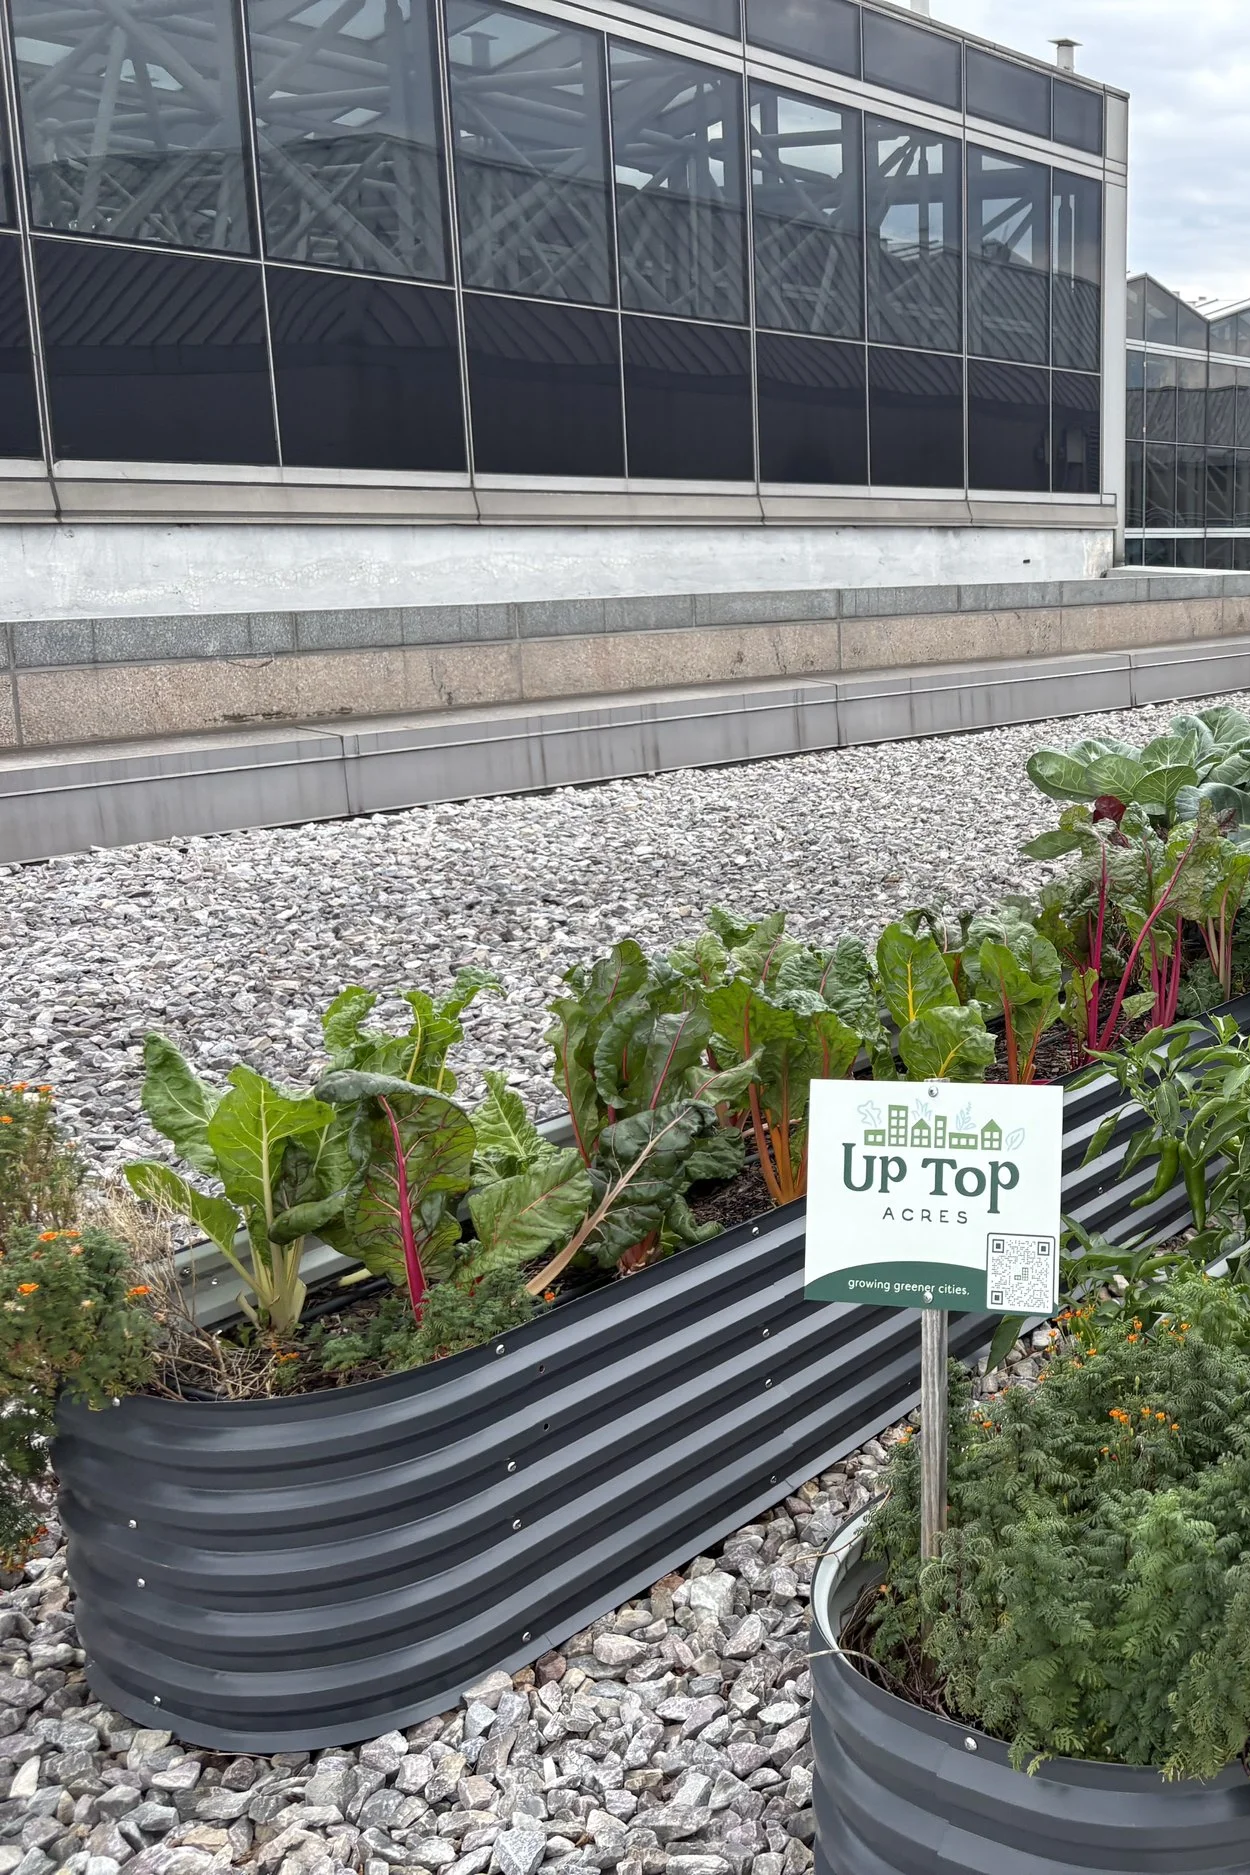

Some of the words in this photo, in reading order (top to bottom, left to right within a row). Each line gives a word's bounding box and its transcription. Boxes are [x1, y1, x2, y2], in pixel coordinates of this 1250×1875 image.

[842, 1143, 907, 1193] Up
[921, 1158, 1020, 1214] Top
[882, 1207, 968, 1224] ACRES
[848, 1279, 891, 1292] growing
[894, 1282, 936, 1294] greener
